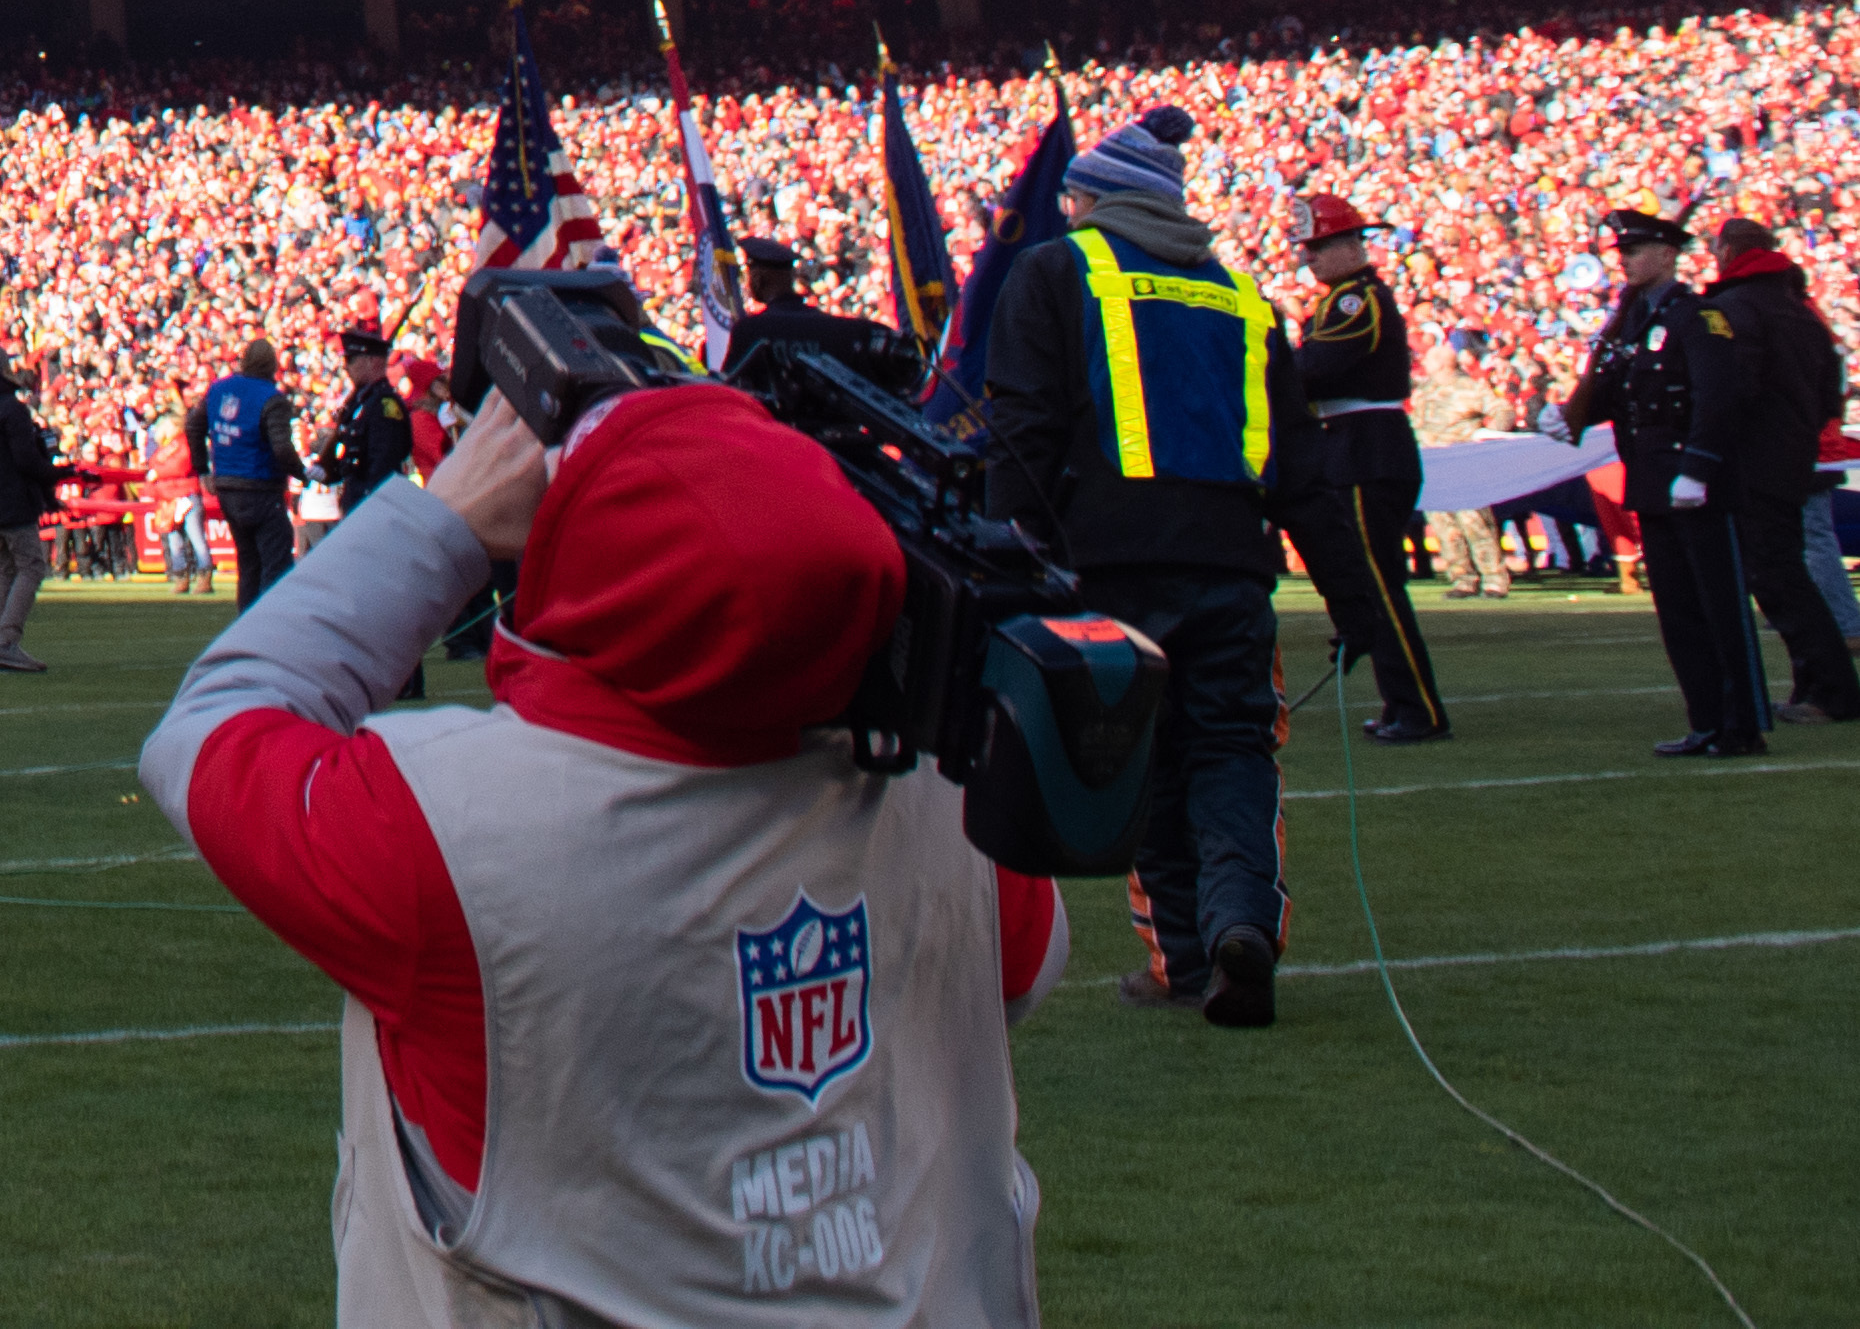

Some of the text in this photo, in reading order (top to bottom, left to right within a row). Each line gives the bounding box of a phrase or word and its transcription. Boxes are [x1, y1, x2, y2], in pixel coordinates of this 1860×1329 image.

[756, 978, 857, 1076] NFL
[731, 1121, 875, 1225] MEDIA
[742, 1196, 884, 1294] KC-006
